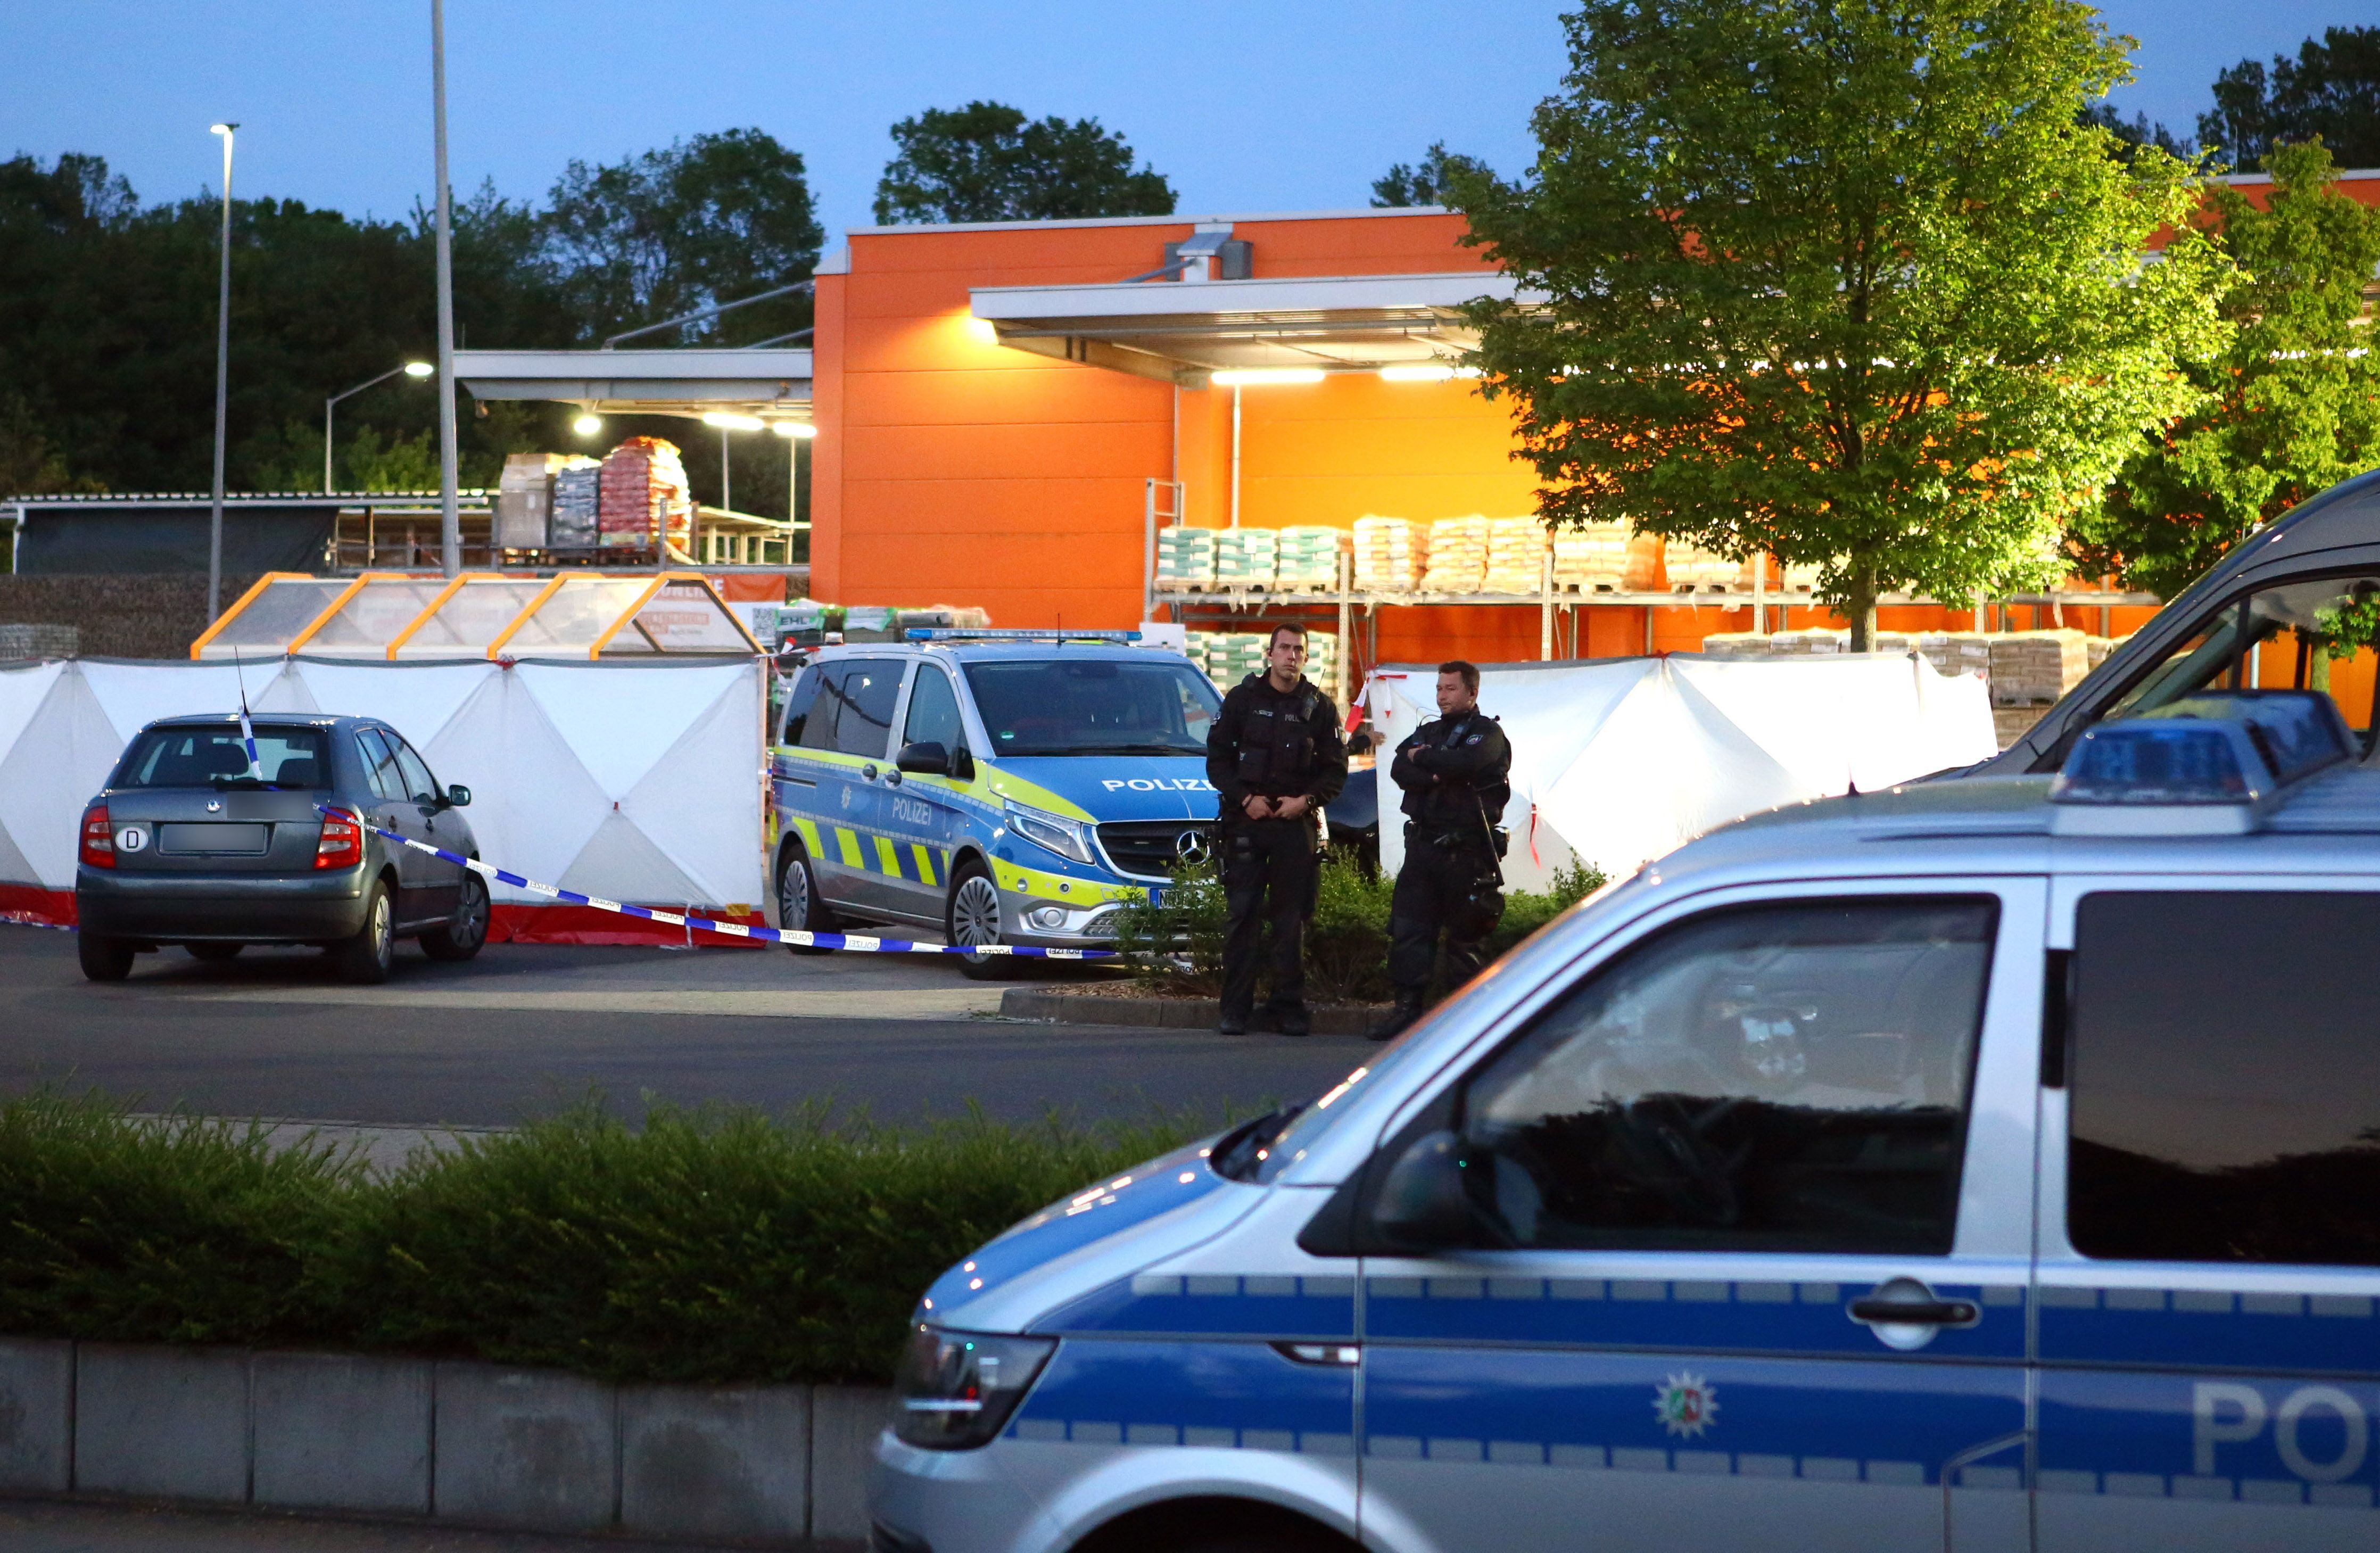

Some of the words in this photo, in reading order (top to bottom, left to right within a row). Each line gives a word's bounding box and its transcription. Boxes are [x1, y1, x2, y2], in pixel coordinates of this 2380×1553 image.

[1285, 714, 1300, 723] POLI
[892, 797, 931, 826] POLIZEI
[127, 831, 138, 848] D
[2193, 1383, 2368, 1482] PO
